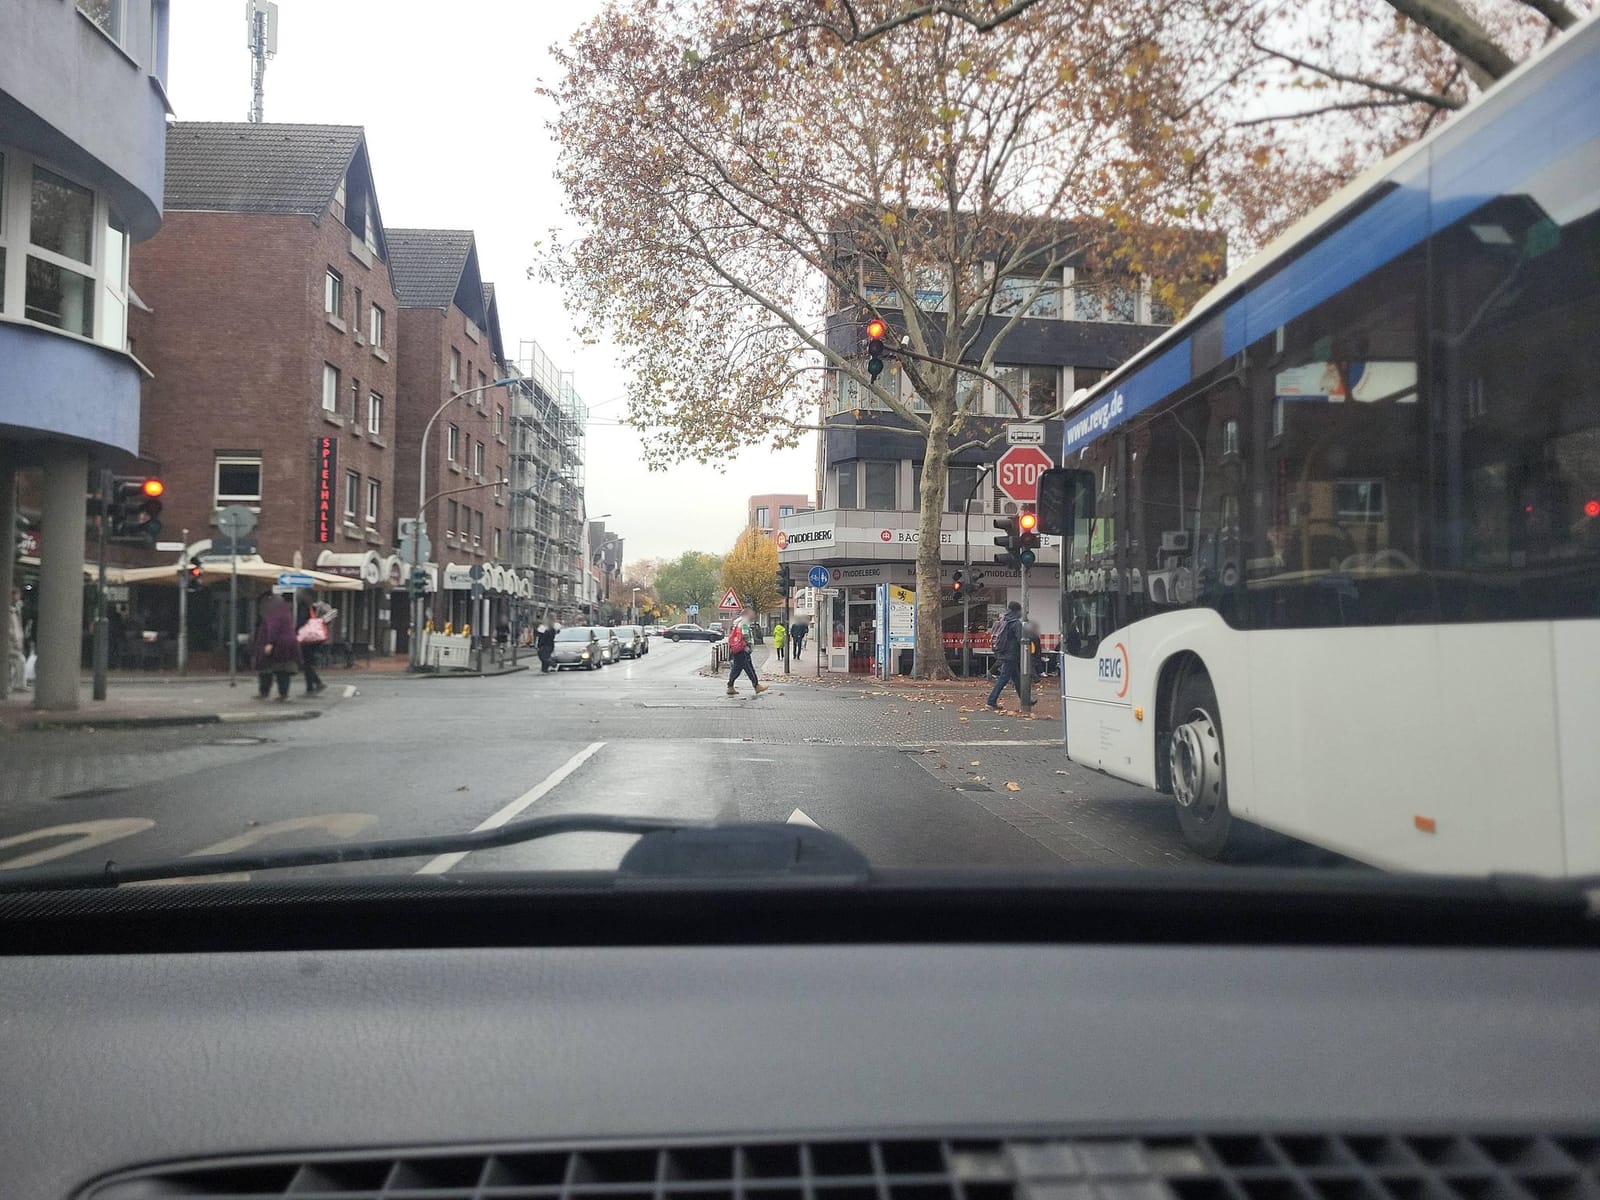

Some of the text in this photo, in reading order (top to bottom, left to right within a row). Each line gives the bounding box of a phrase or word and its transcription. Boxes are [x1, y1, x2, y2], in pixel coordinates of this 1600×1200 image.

[1067, 390, 1123, 445] www.revg.de
[320, 438, 330, 542] SPIELHALLE
[788, 530, 832, 544] MIDDELBERG
[842, 568, 880, 578] MIDDELBERG
[984, 570, 1032, 578] MIDDELBEG
[1099, 658, 1122, 679] REVG
